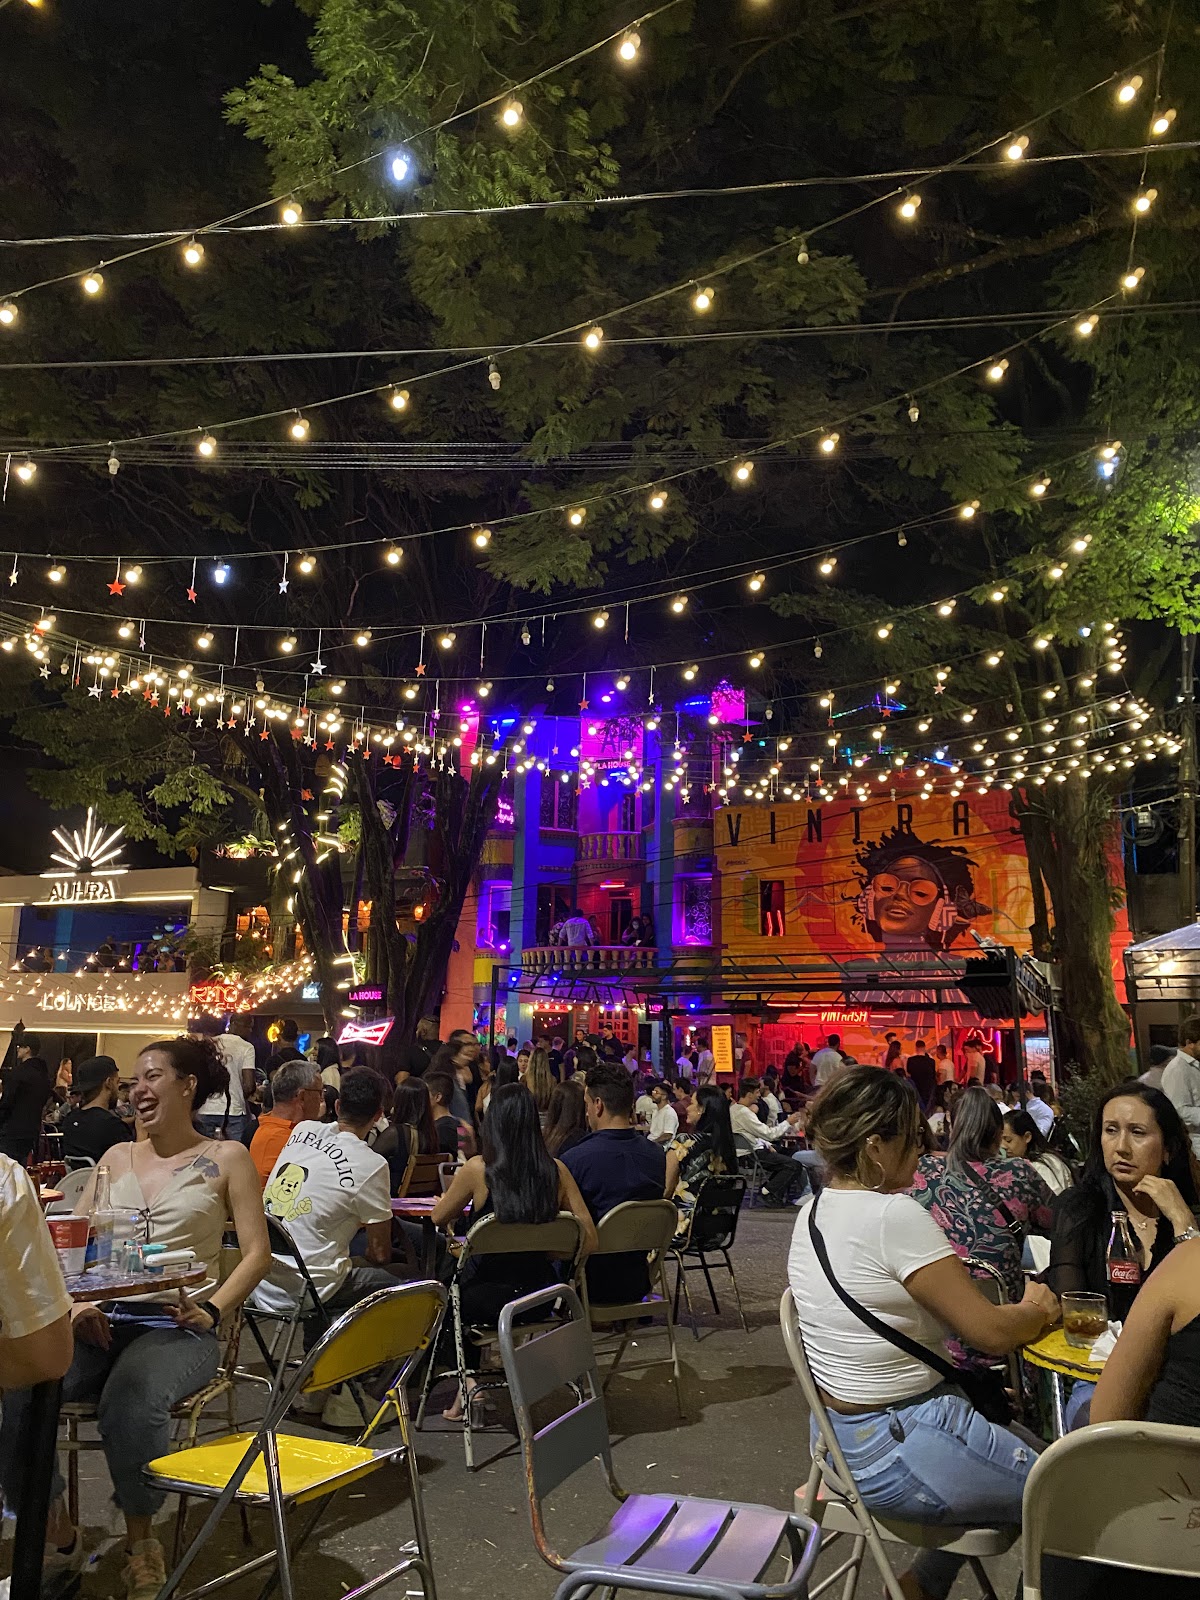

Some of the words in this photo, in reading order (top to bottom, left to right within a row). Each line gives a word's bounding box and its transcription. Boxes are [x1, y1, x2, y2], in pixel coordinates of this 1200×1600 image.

[598, 761, 607, 770] LA
[608, 760, 631, 769] HOUSE
[348, 992, 358, 1000] LA
[359, 991, 382, 1000] HOUSE
[284, 1131, 355, 1188] OLFAHOLIC
